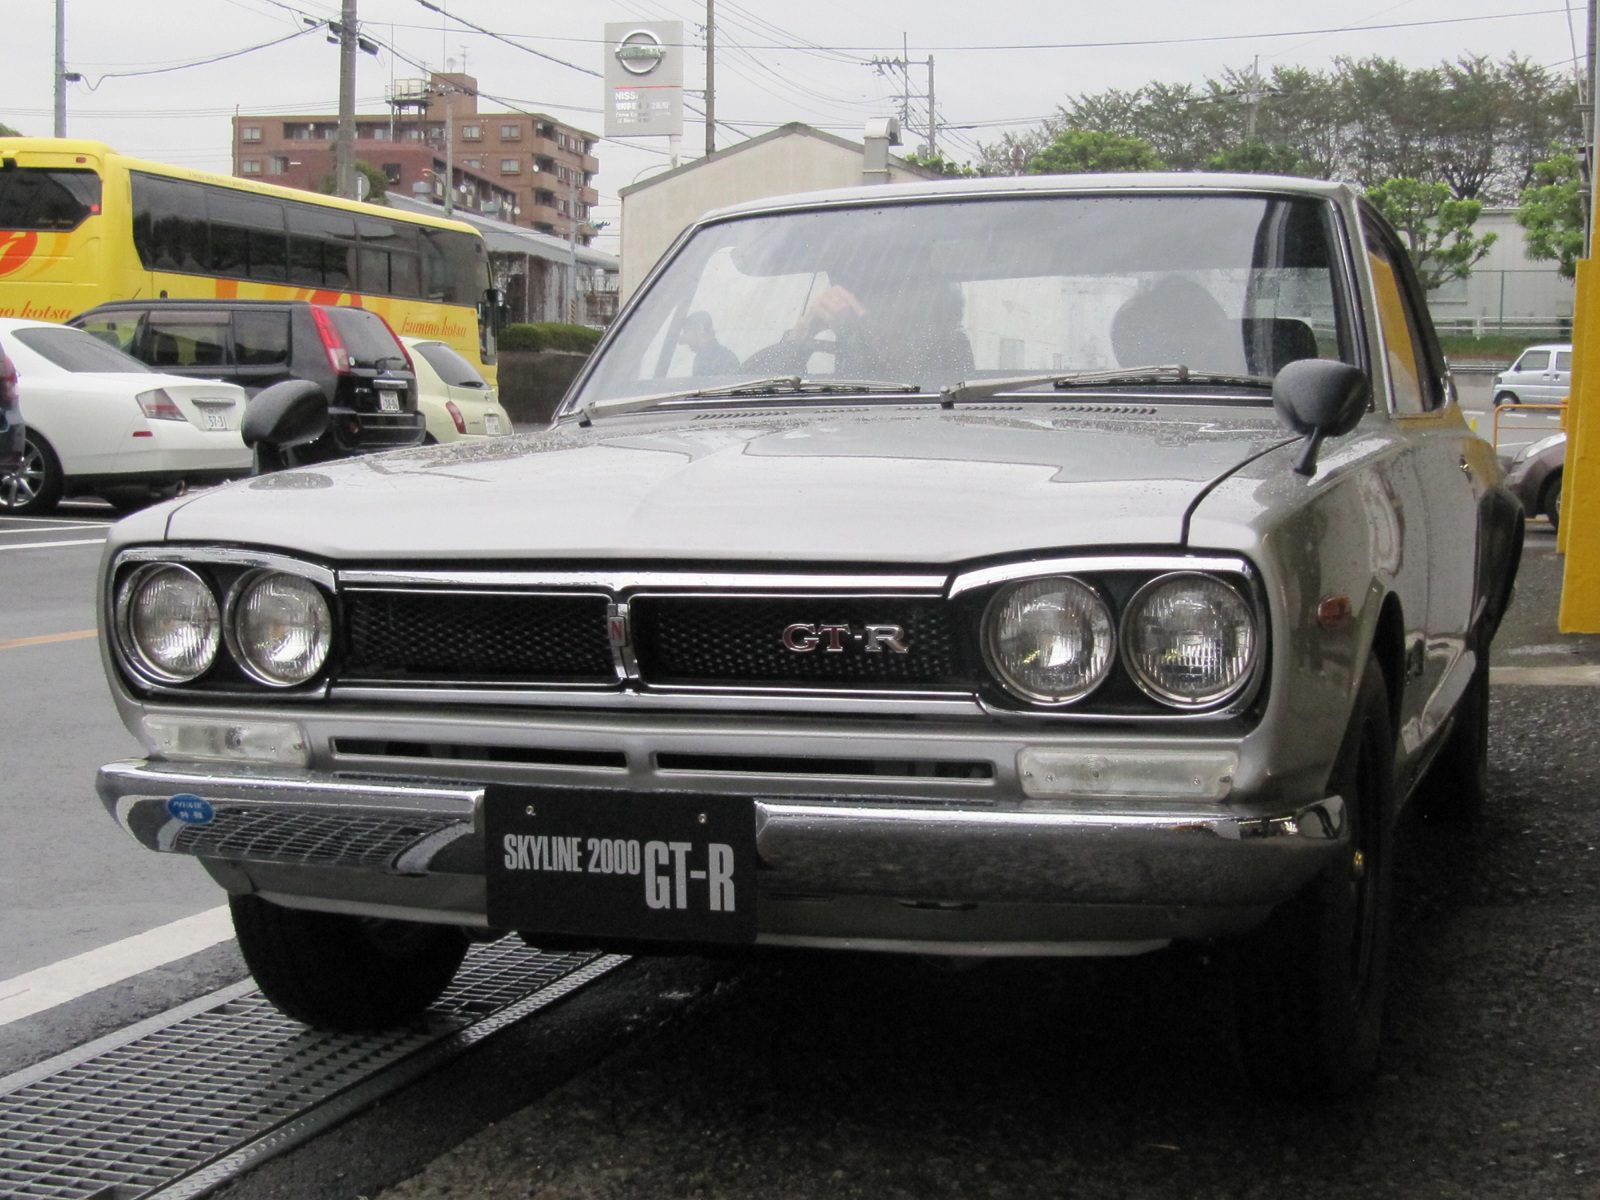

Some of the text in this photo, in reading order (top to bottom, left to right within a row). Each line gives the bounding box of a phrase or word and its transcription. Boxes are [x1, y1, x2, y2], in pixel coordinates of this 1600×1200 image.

[782, 622, 909, 654] GT-R
[503, 833, 736, 912] SKYLINE 2000 GT-R
